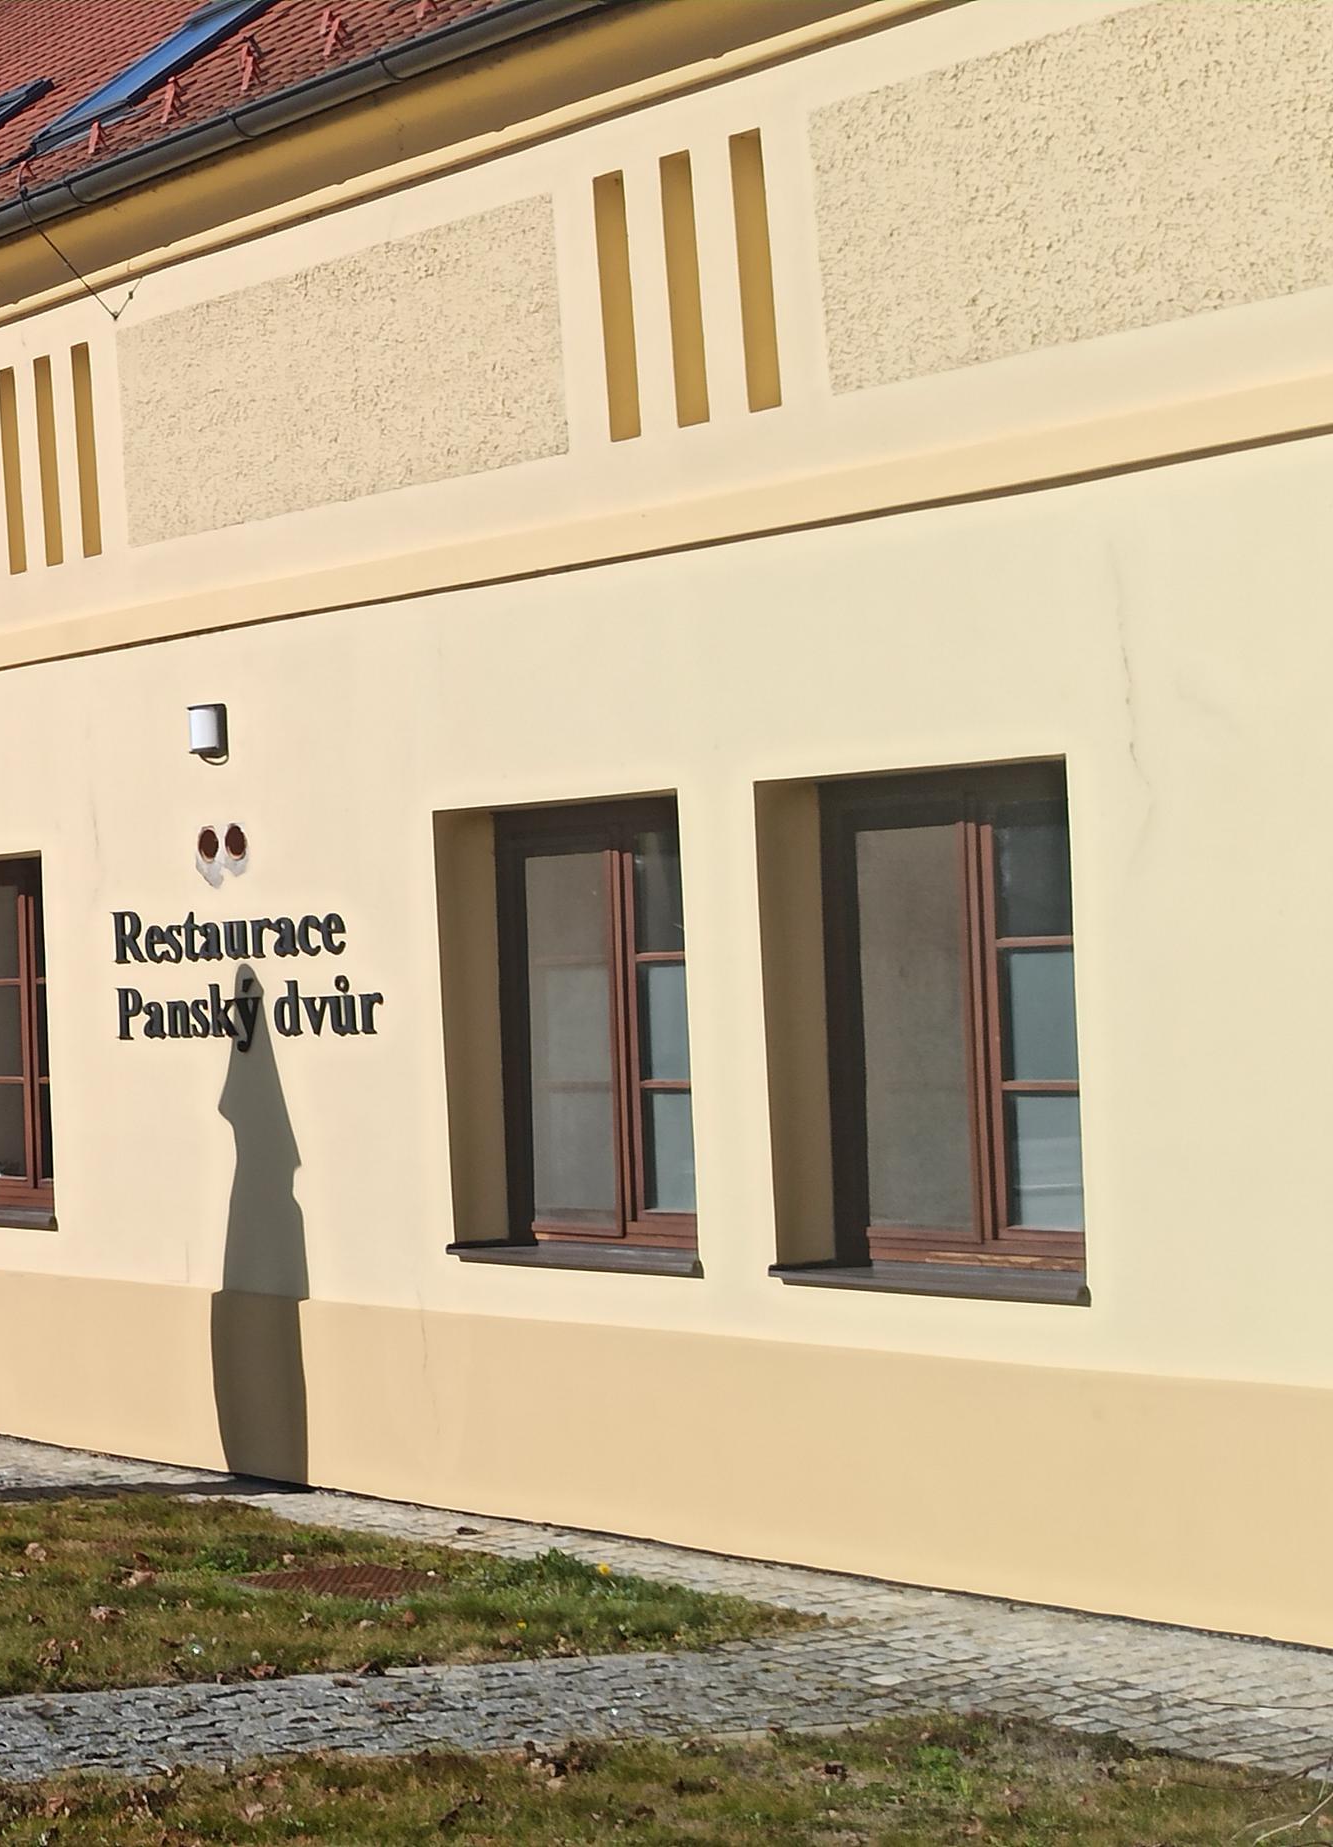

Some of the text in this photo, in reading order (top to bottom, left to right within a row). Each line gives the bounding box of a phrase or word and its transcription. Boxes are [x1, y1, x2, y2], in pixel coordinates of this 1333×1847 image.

[109, 910, 346, 964] Restaurace
[115, 974, 384, 1053] Panský dvůr
